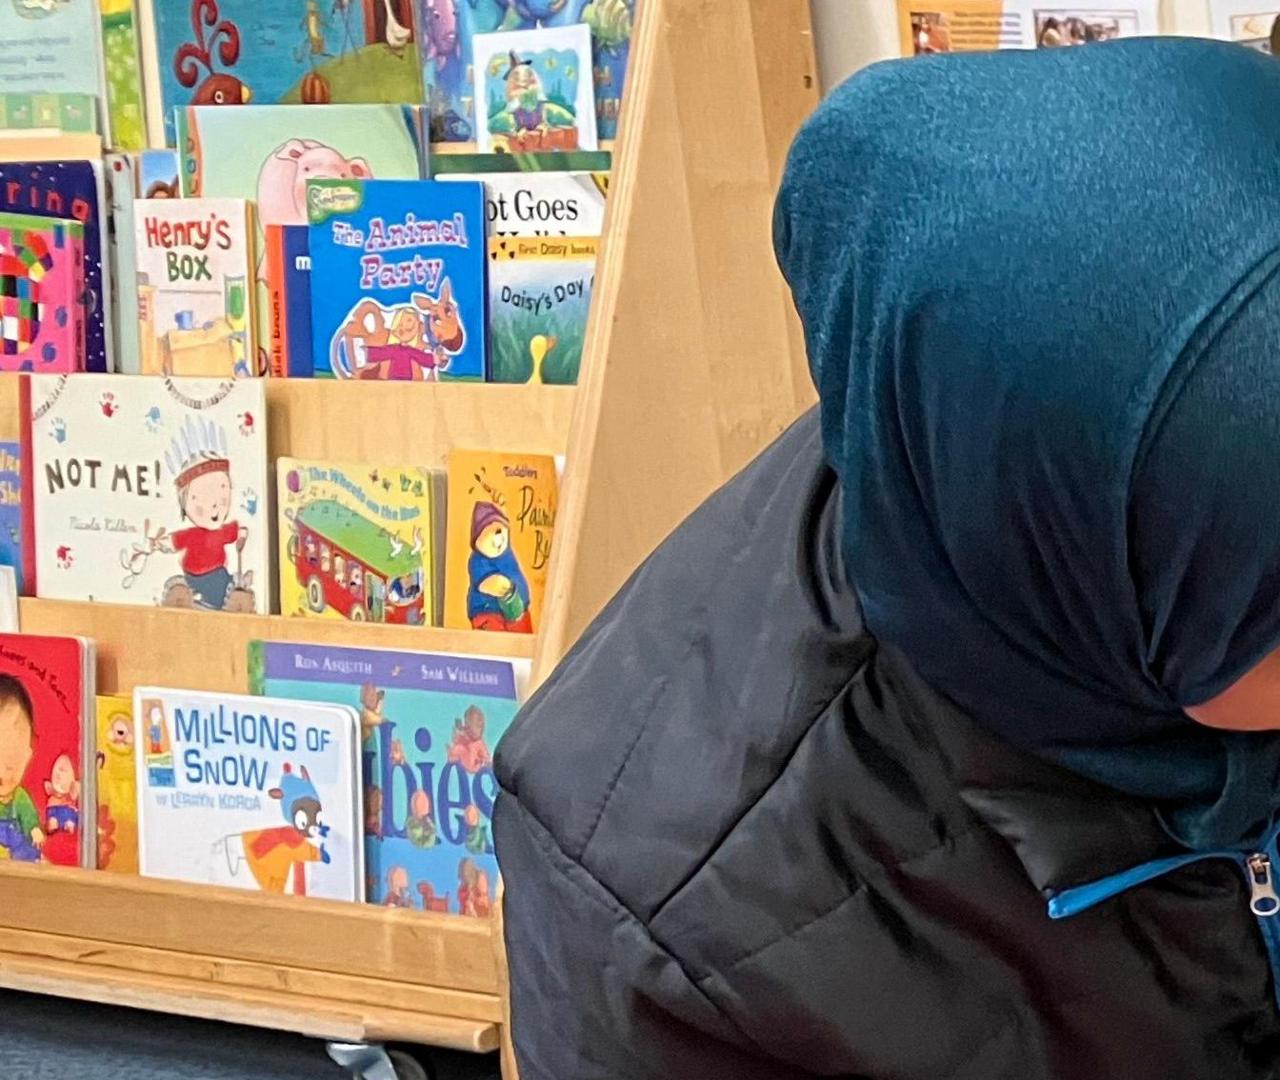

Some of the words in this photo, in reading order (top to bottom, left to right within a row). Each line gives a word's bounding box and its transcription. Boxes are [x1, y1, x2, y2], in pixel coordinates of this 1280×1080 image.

[514, 189, 579, 221] Goes
[145, 213, 231, 250] Henry's
[331, 222, 363, 247] The
[364, 211, 469, 252] Animal
[166, 251, 212, 282] BOX
[360, 254, 444, 296] Party
[501, 286, 552, 316] Daisy's
[554, 279, 584, 302] Day
[45, 458, 102, 494] NOT
[111, 460, 163, 498] ME!
[446, 665, 499, 686] WILLIAMS
[174, 704, 297, 751] MILLIONS
[306, 726, 331, 752] OF
[184, 749, 268, 790] SNOW
